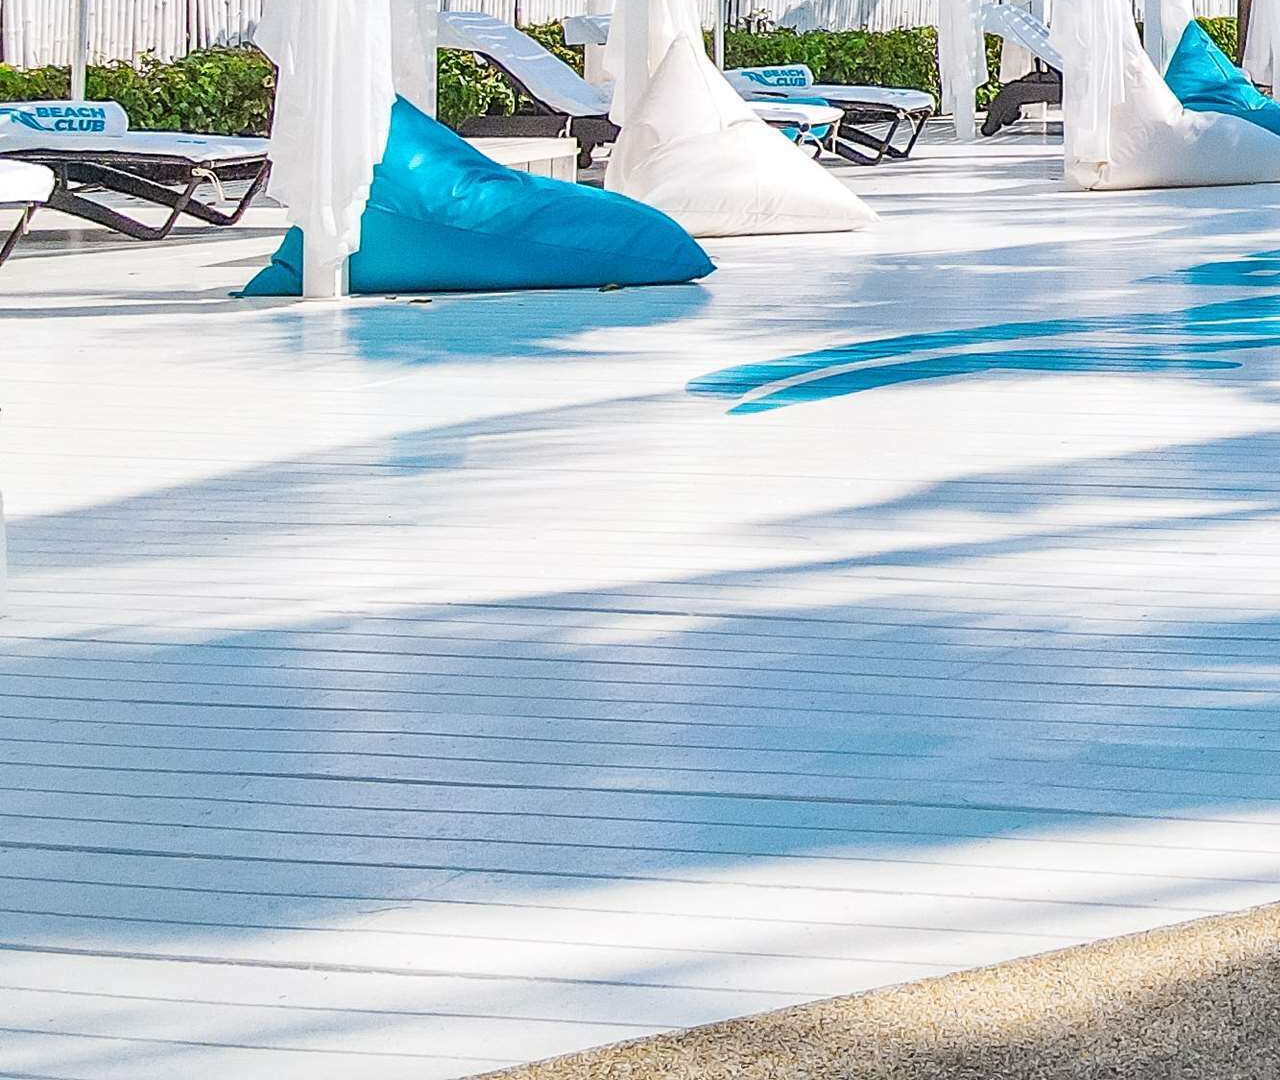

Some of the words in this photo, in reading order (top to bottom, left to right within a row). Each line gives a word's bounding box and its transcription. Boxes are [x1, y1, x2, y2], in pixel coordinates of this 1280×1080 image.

[763, 70, 805, 78] BEACH
[776, 78, 806, 87] CLUB
[36, 107, 106, 118] BEACH
[54, 120, 105, 132] CLUB
